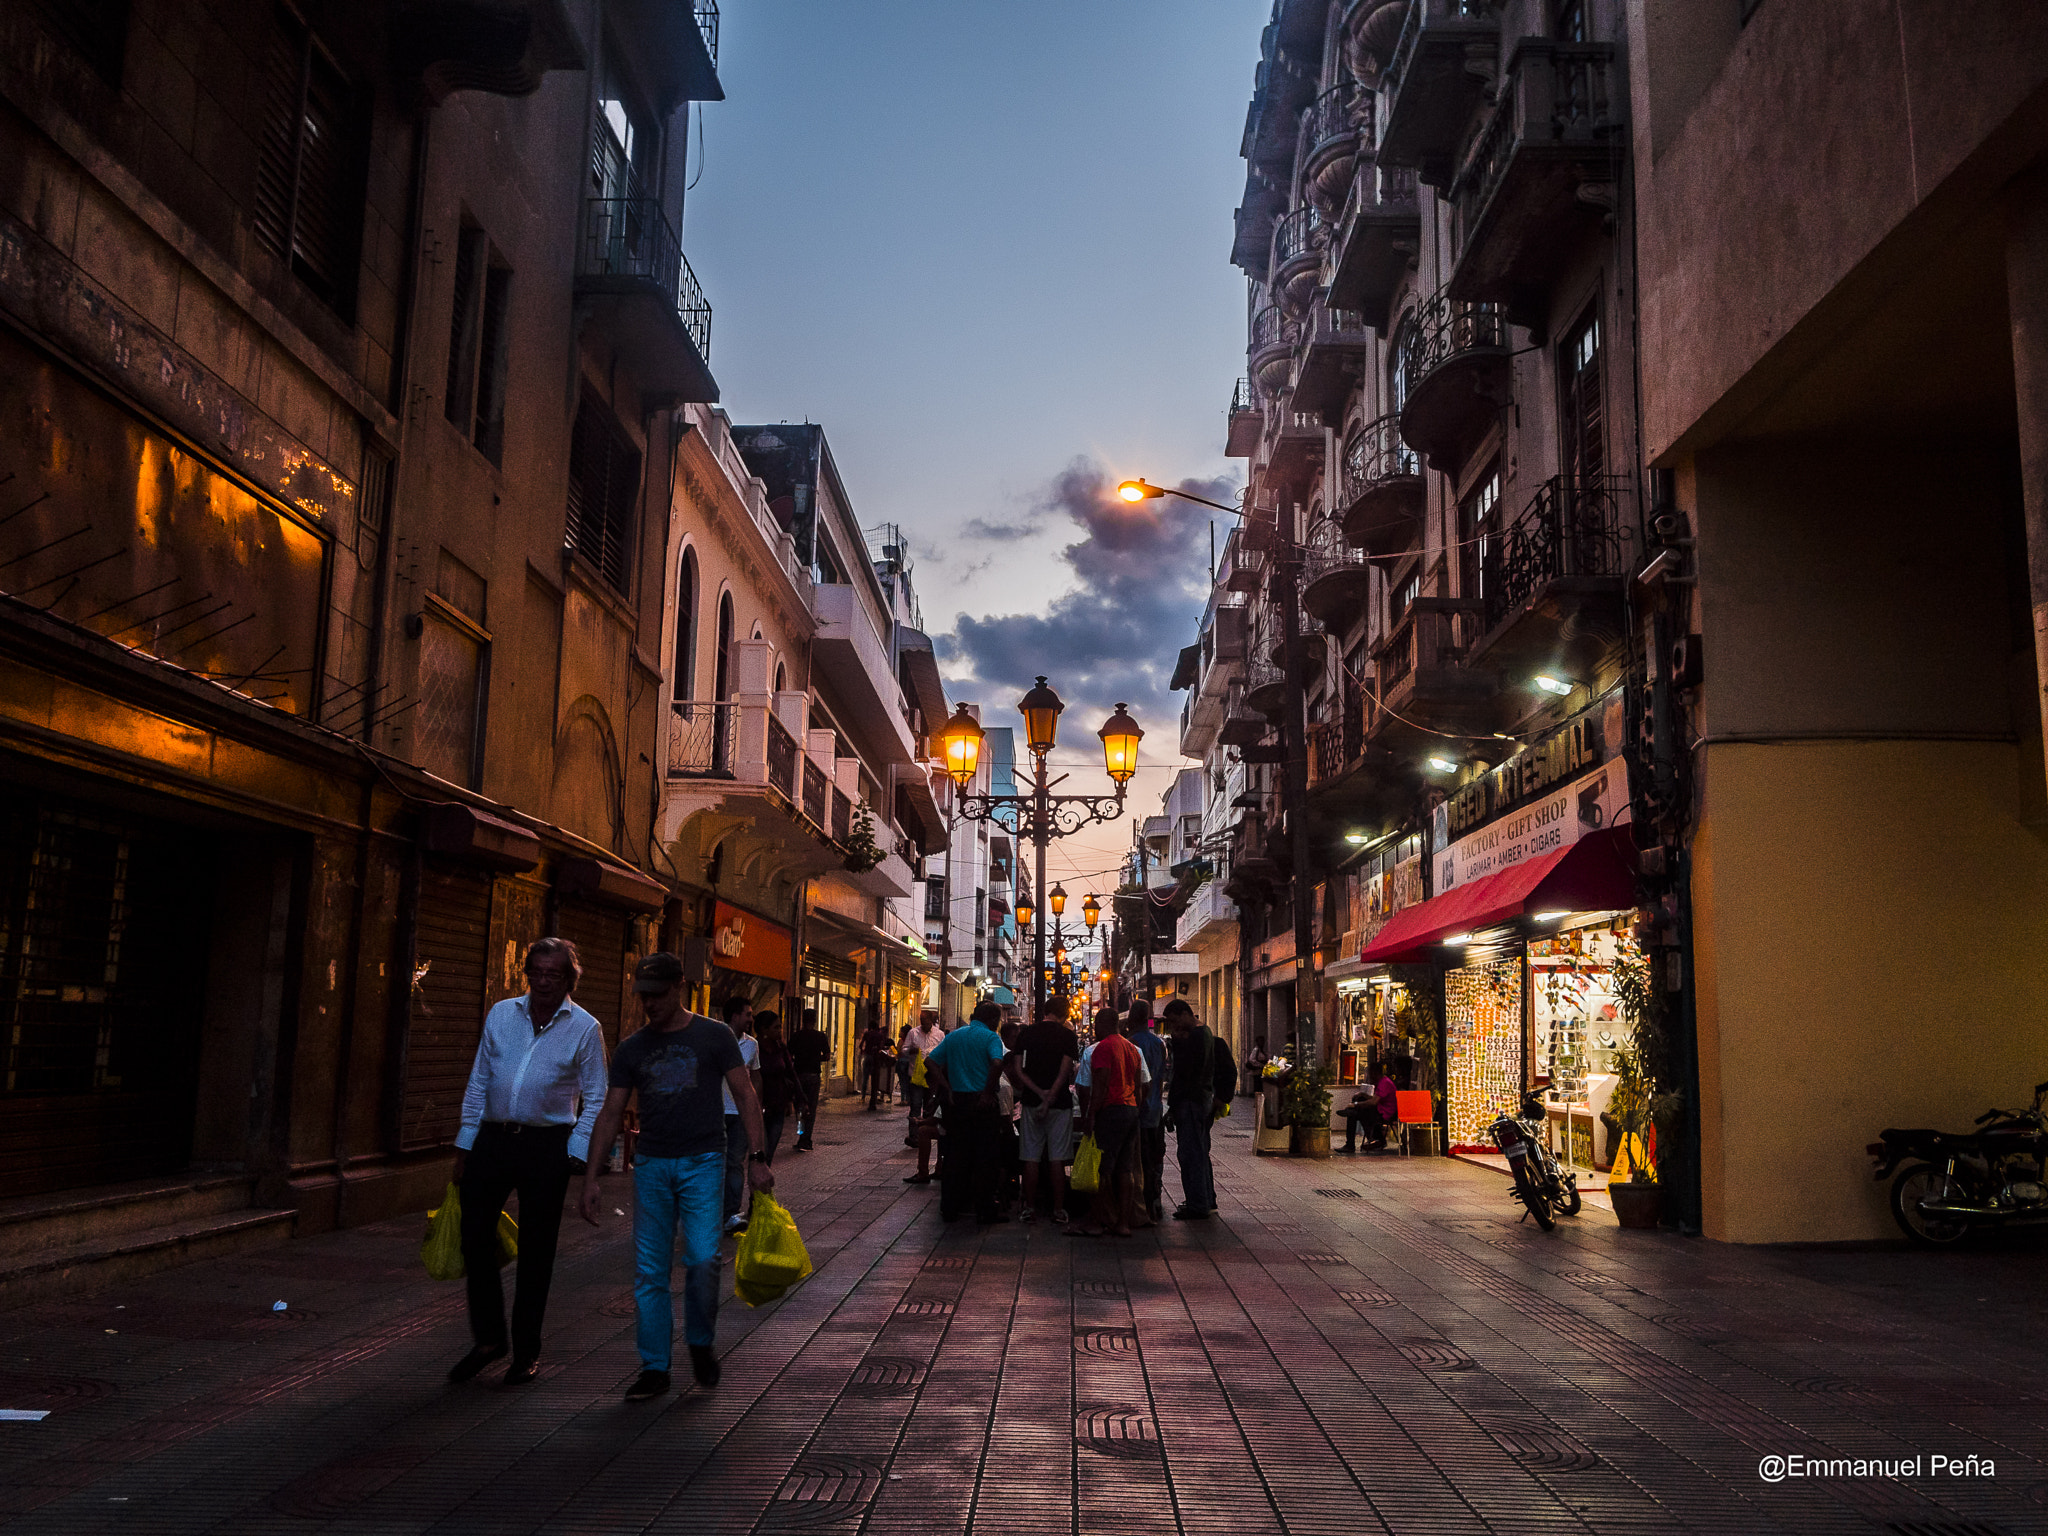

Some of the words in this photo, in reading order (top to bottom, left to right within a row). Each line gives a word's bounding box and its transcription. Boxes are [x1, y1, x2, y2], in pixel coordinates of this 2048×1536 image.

[1461, 829, 1500, 861] FACTORY
[1507, 812, 1532, 841] GIFT
[1534, 797, 1567, 828] SHOP
[1466, 856, 1492, 879] LARIMAR
[1498, 844, 1522, 866] AMBER
[1530, 828, 1561, 854] CIGARS
[721, 925, 741, 958] Claro
